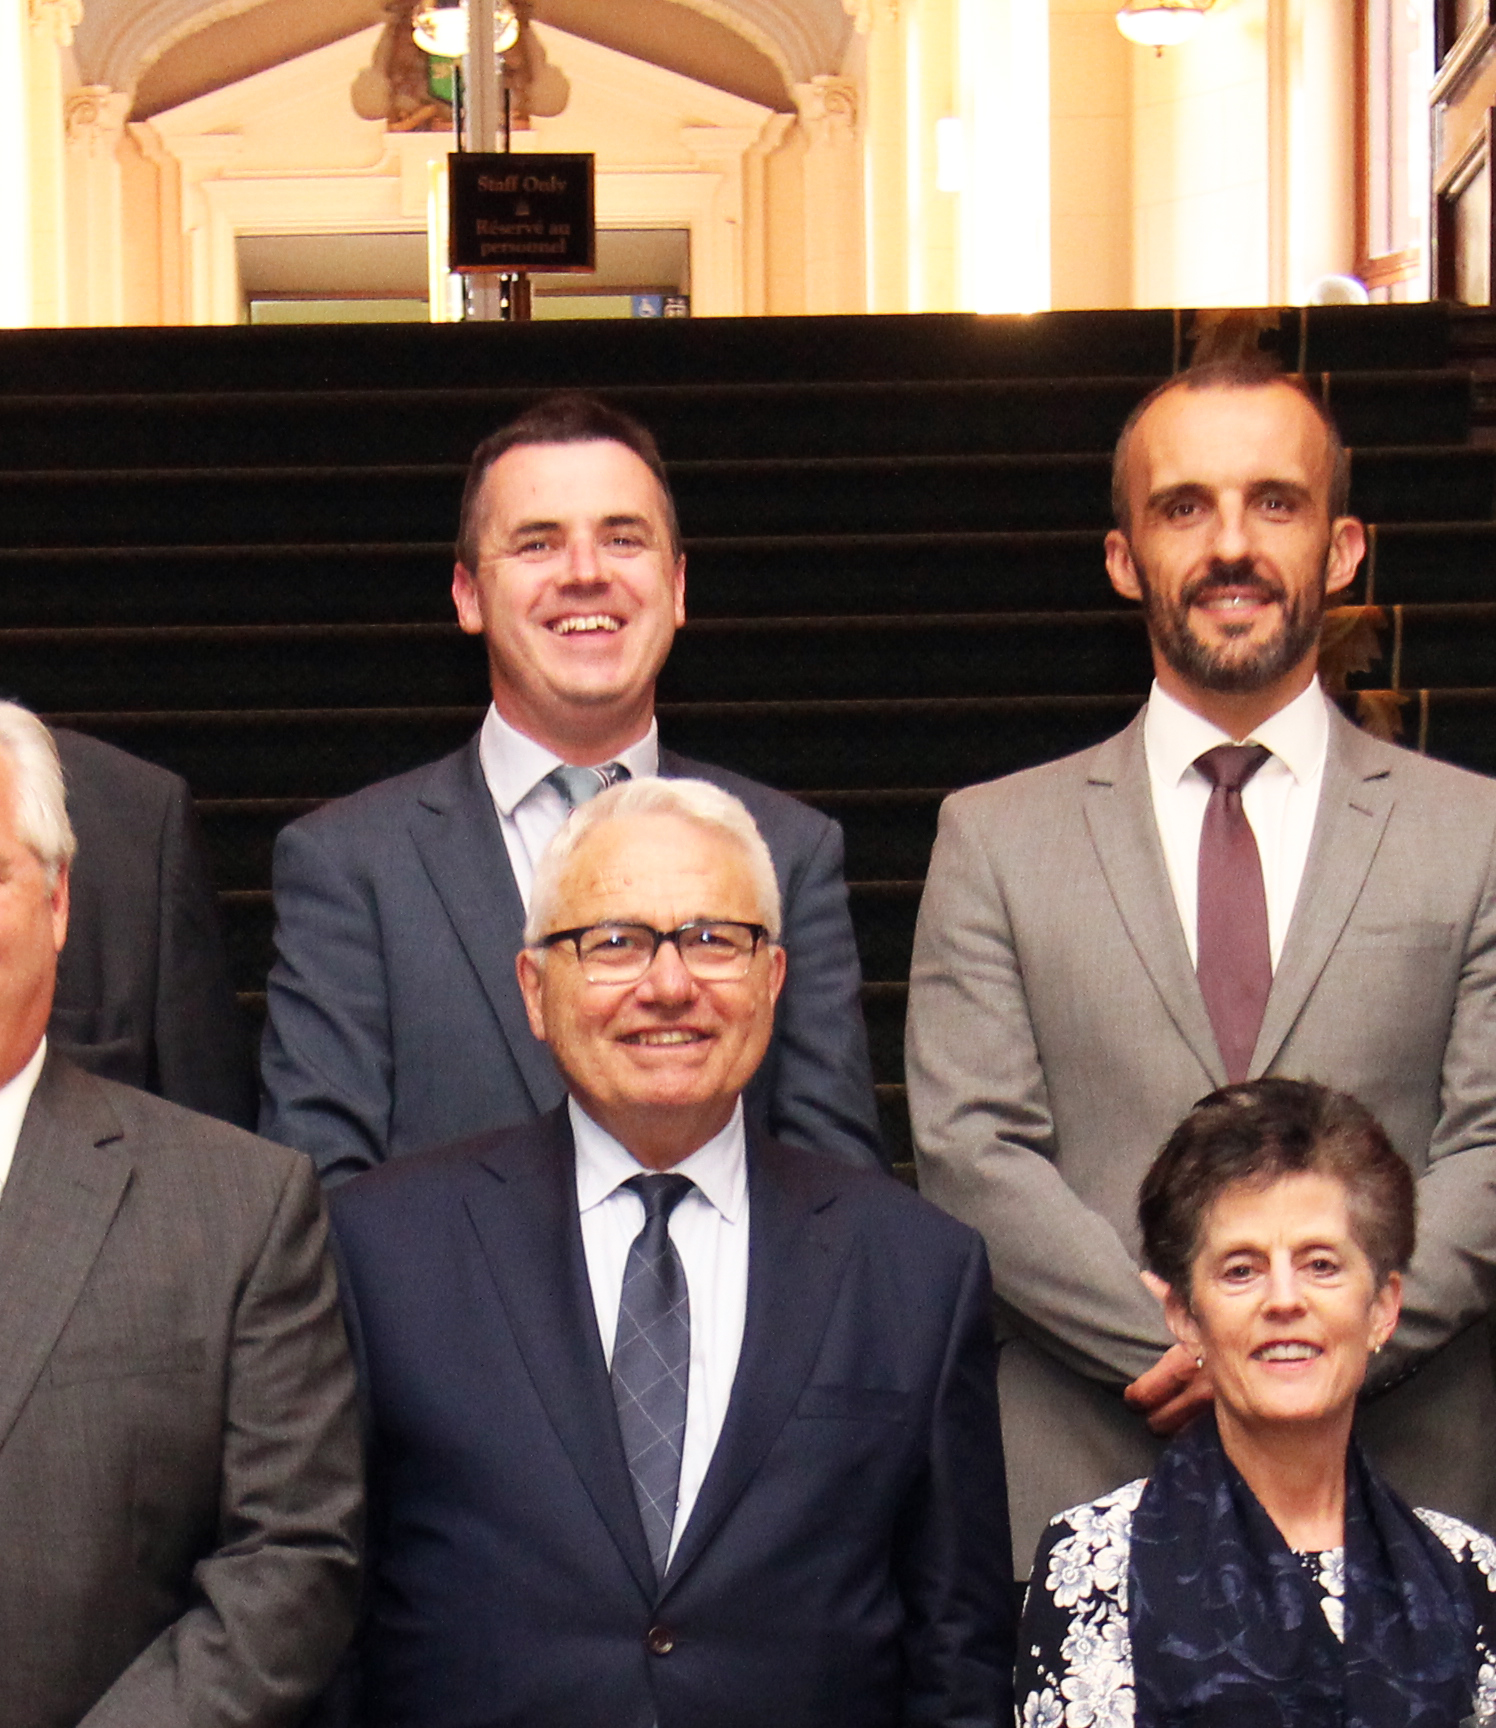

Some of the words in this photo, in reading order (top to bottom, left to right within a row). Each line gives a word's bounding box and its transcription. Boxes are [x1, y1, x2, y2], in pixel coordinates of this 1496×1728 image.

[477, 173, 519, 192] Staff
[522, 173, 567, 194] Only
[549, 223, 571, 236] au
[480, 237, 567, 257] personnel
